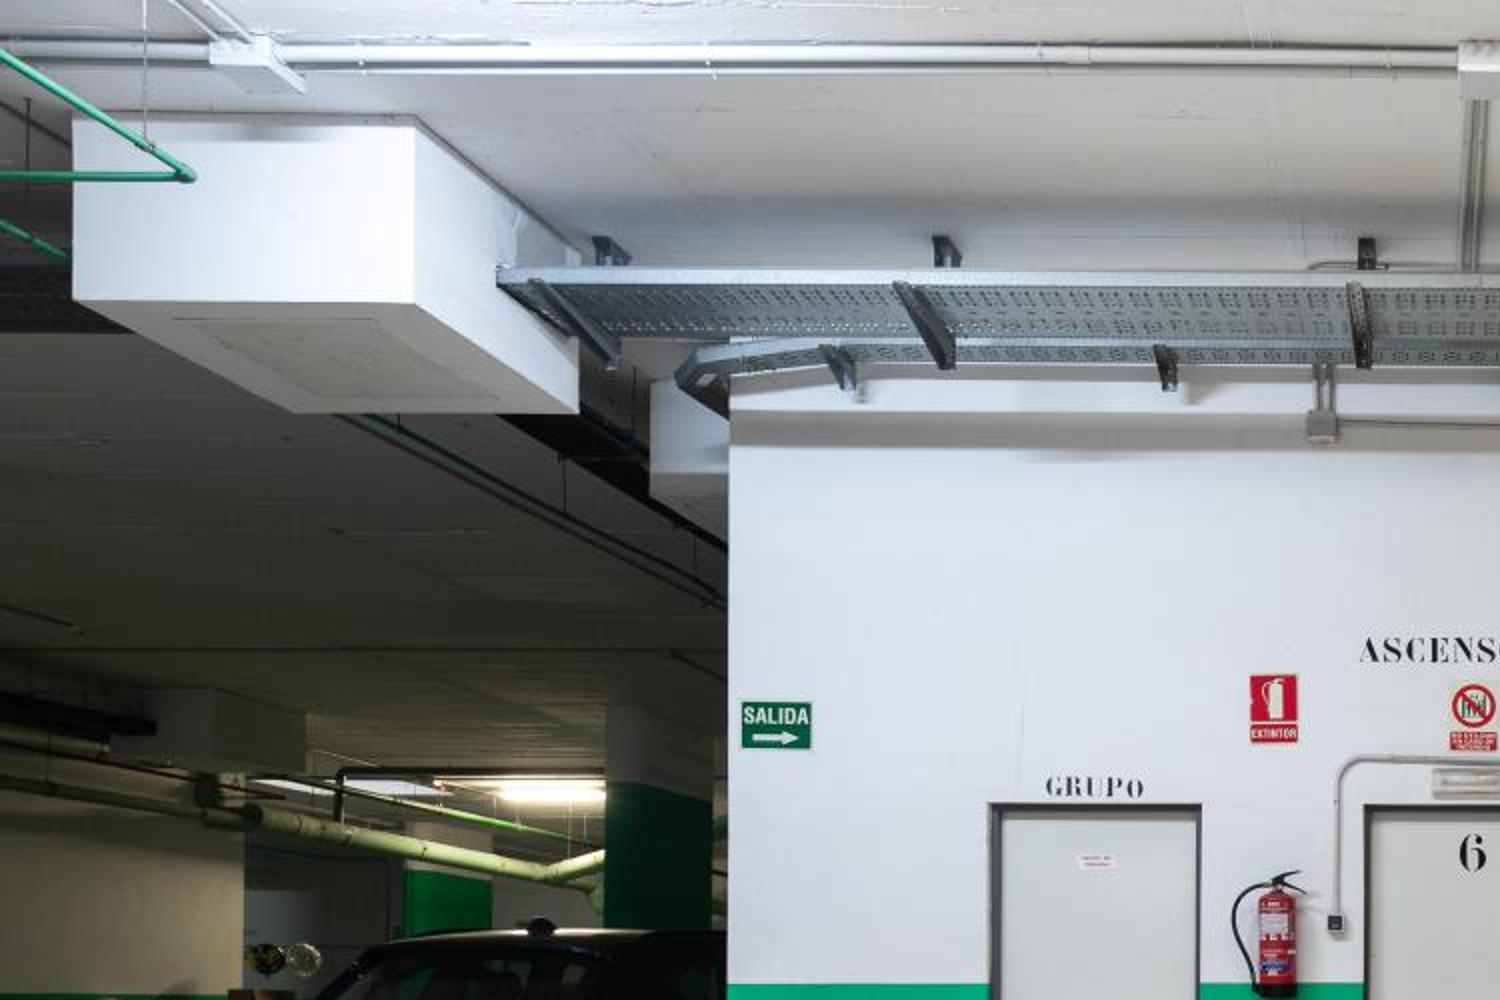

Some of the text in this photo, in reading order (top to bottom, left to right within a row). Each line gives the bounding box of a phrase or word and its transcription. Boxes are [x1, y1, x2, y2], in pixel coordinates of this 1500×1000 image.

[743, 706, 809, 725] SALIDA
[1045, 776, 1144, 798] GRUPO
[1459, 833, 1487, 872] 6
